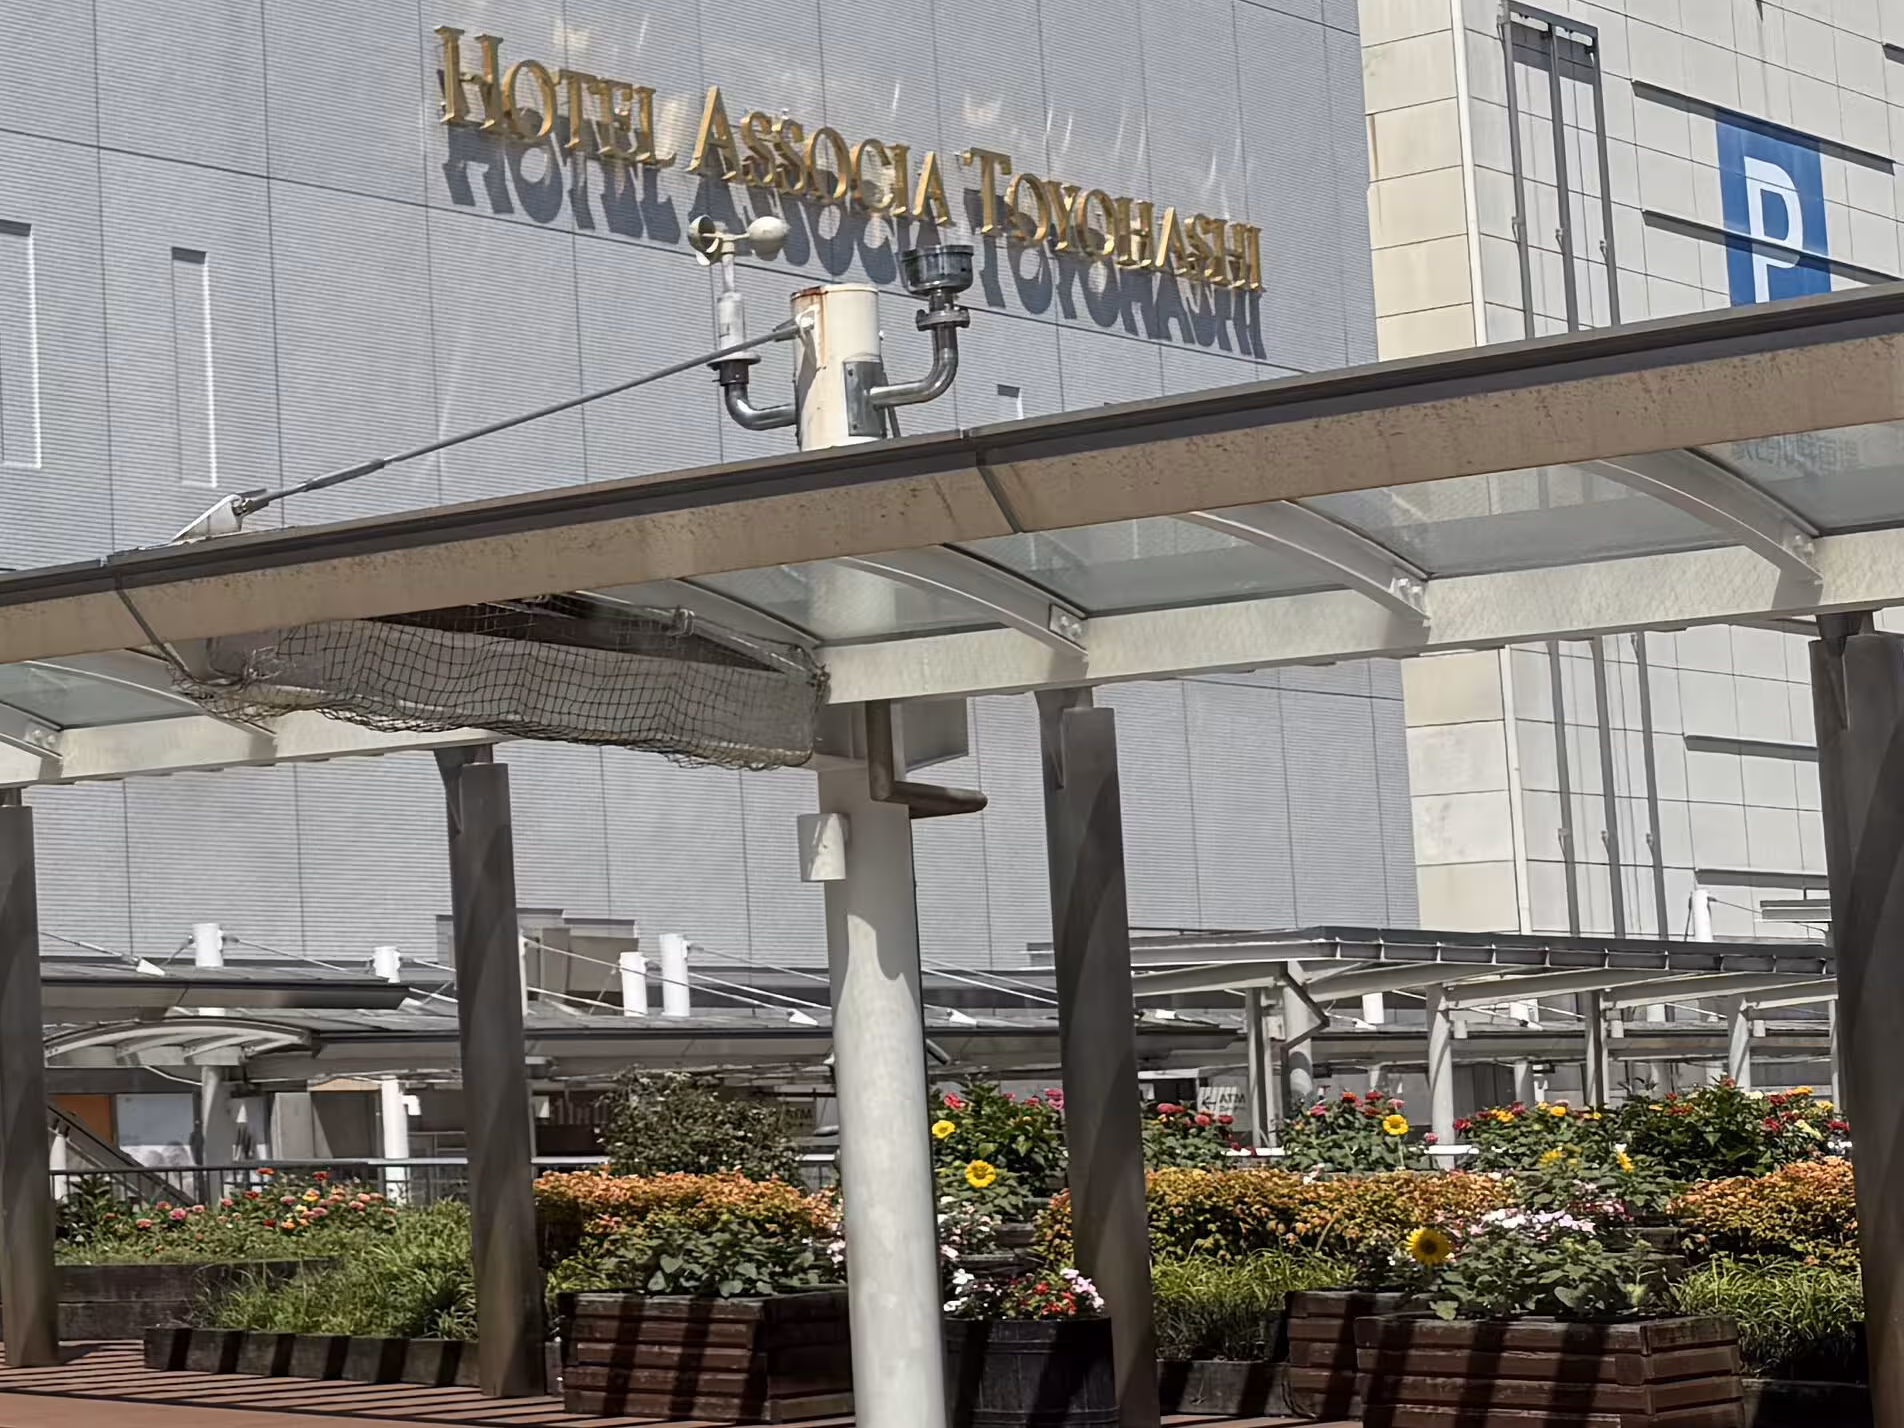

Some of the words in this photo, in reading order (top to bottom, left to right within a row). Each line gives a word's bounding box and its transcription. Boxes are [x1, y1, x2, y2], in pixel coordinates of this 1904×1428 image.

[435, 24, 678, 167] HOTEL
[687, 85, 954, 227] ASSOCIA
[964, 146, 1265, 293] TOYOHASHI
[1744, 156, 1804, 304] P
